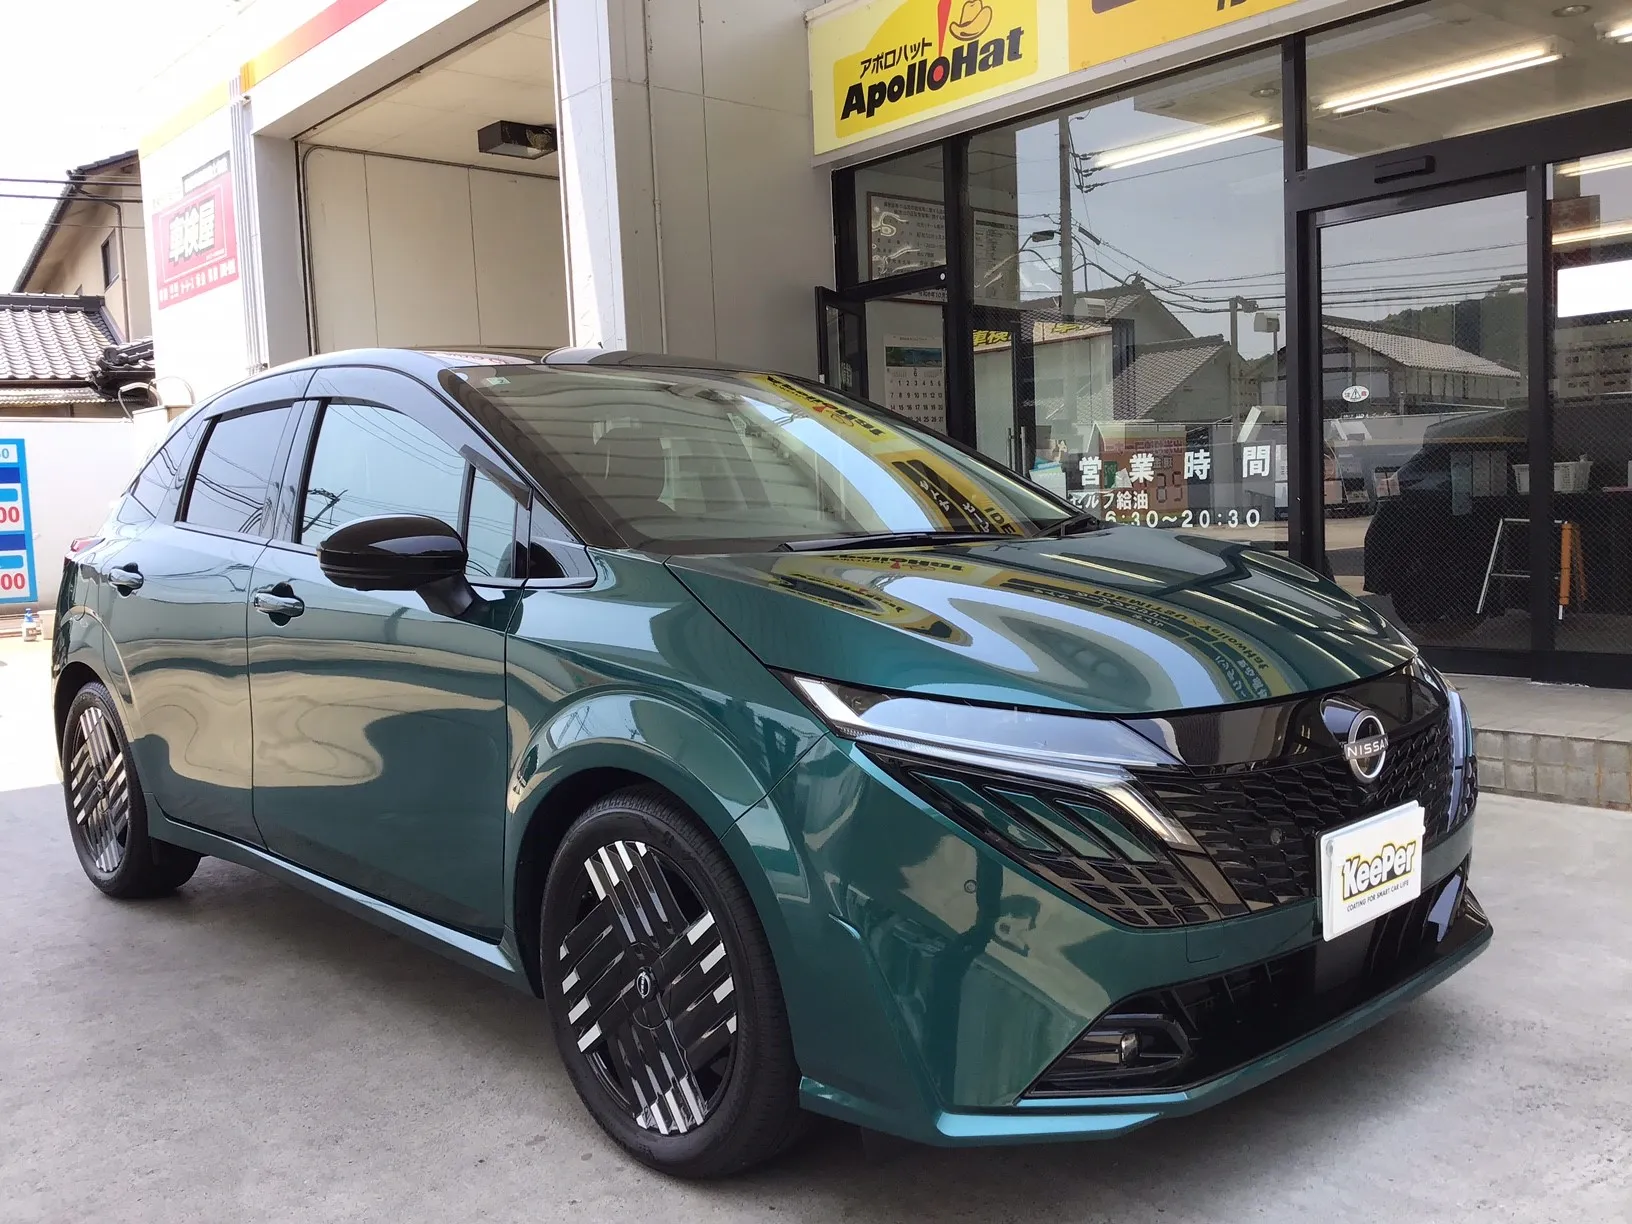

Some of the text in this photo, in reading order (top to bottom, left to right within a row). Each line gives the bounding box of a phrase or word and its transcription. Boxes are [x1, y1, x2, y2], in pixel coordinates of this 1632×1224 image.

[840, 26, 1025, 120] ApolloHat
[860, 38, 932, 79] アポロハット
[0, 448, 10, 459] 0
[1079, 445, 1271, 487] 営業時間
[1069, 491, 1149, 511] セルフ給油
[1346, 737, 1389, 758] NISSAN
[1342, 840, 1417, 901] KeePer
[1346, 880, 1409, 913] COATING FOR SMART CAR LIFE
